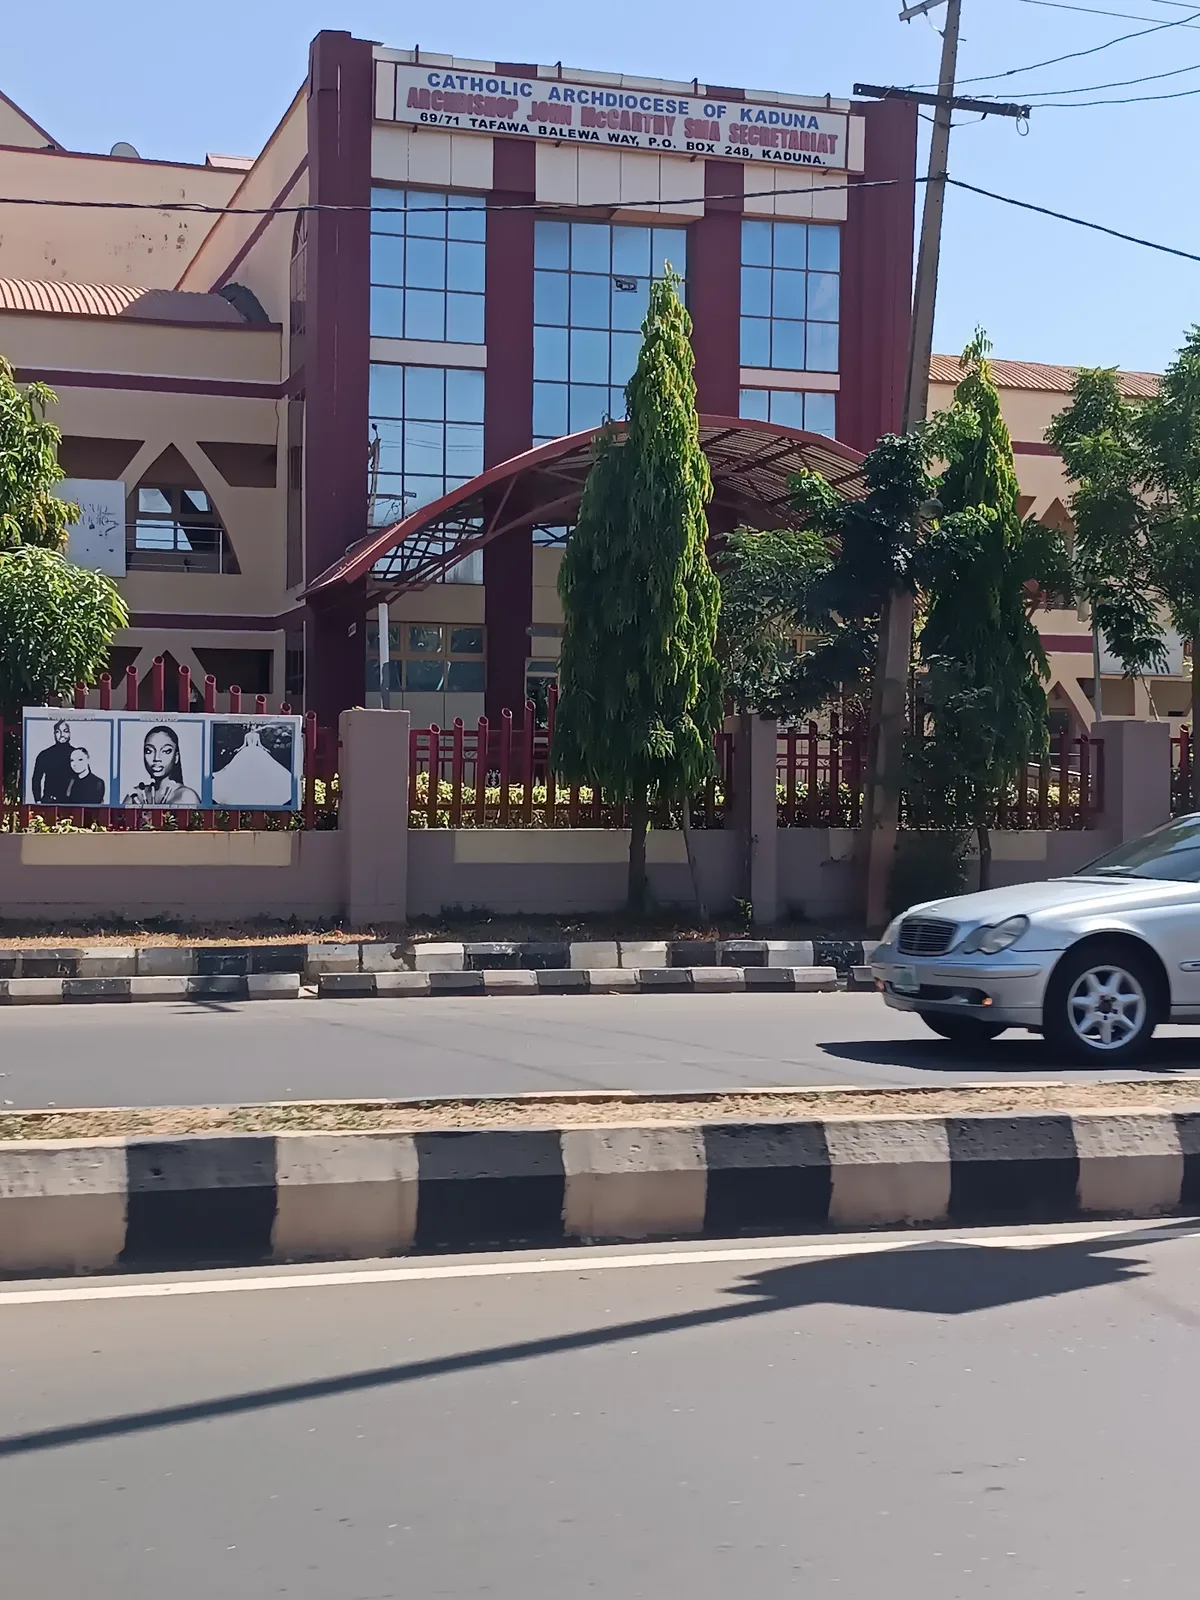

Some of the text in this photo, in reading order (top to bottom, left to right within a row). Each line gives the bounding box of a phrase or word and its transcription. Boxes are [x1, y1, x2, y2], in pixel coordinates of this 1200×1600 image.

[406, 86, 519, 120] ARCHBISHOP
[526, 100, 572, 126] JOHN
[684, 117, 721, 142] SMA
[728, 122, 839, 155] SECRETARIAT
[427, 72, 819, 130] CATHOLIC ARCHDIOCESE OF KADUNA
[420, 112, 826, 165] 69/71 TAFAWA BALEWA WAY, P.O. BOX 248, KADUNA.
